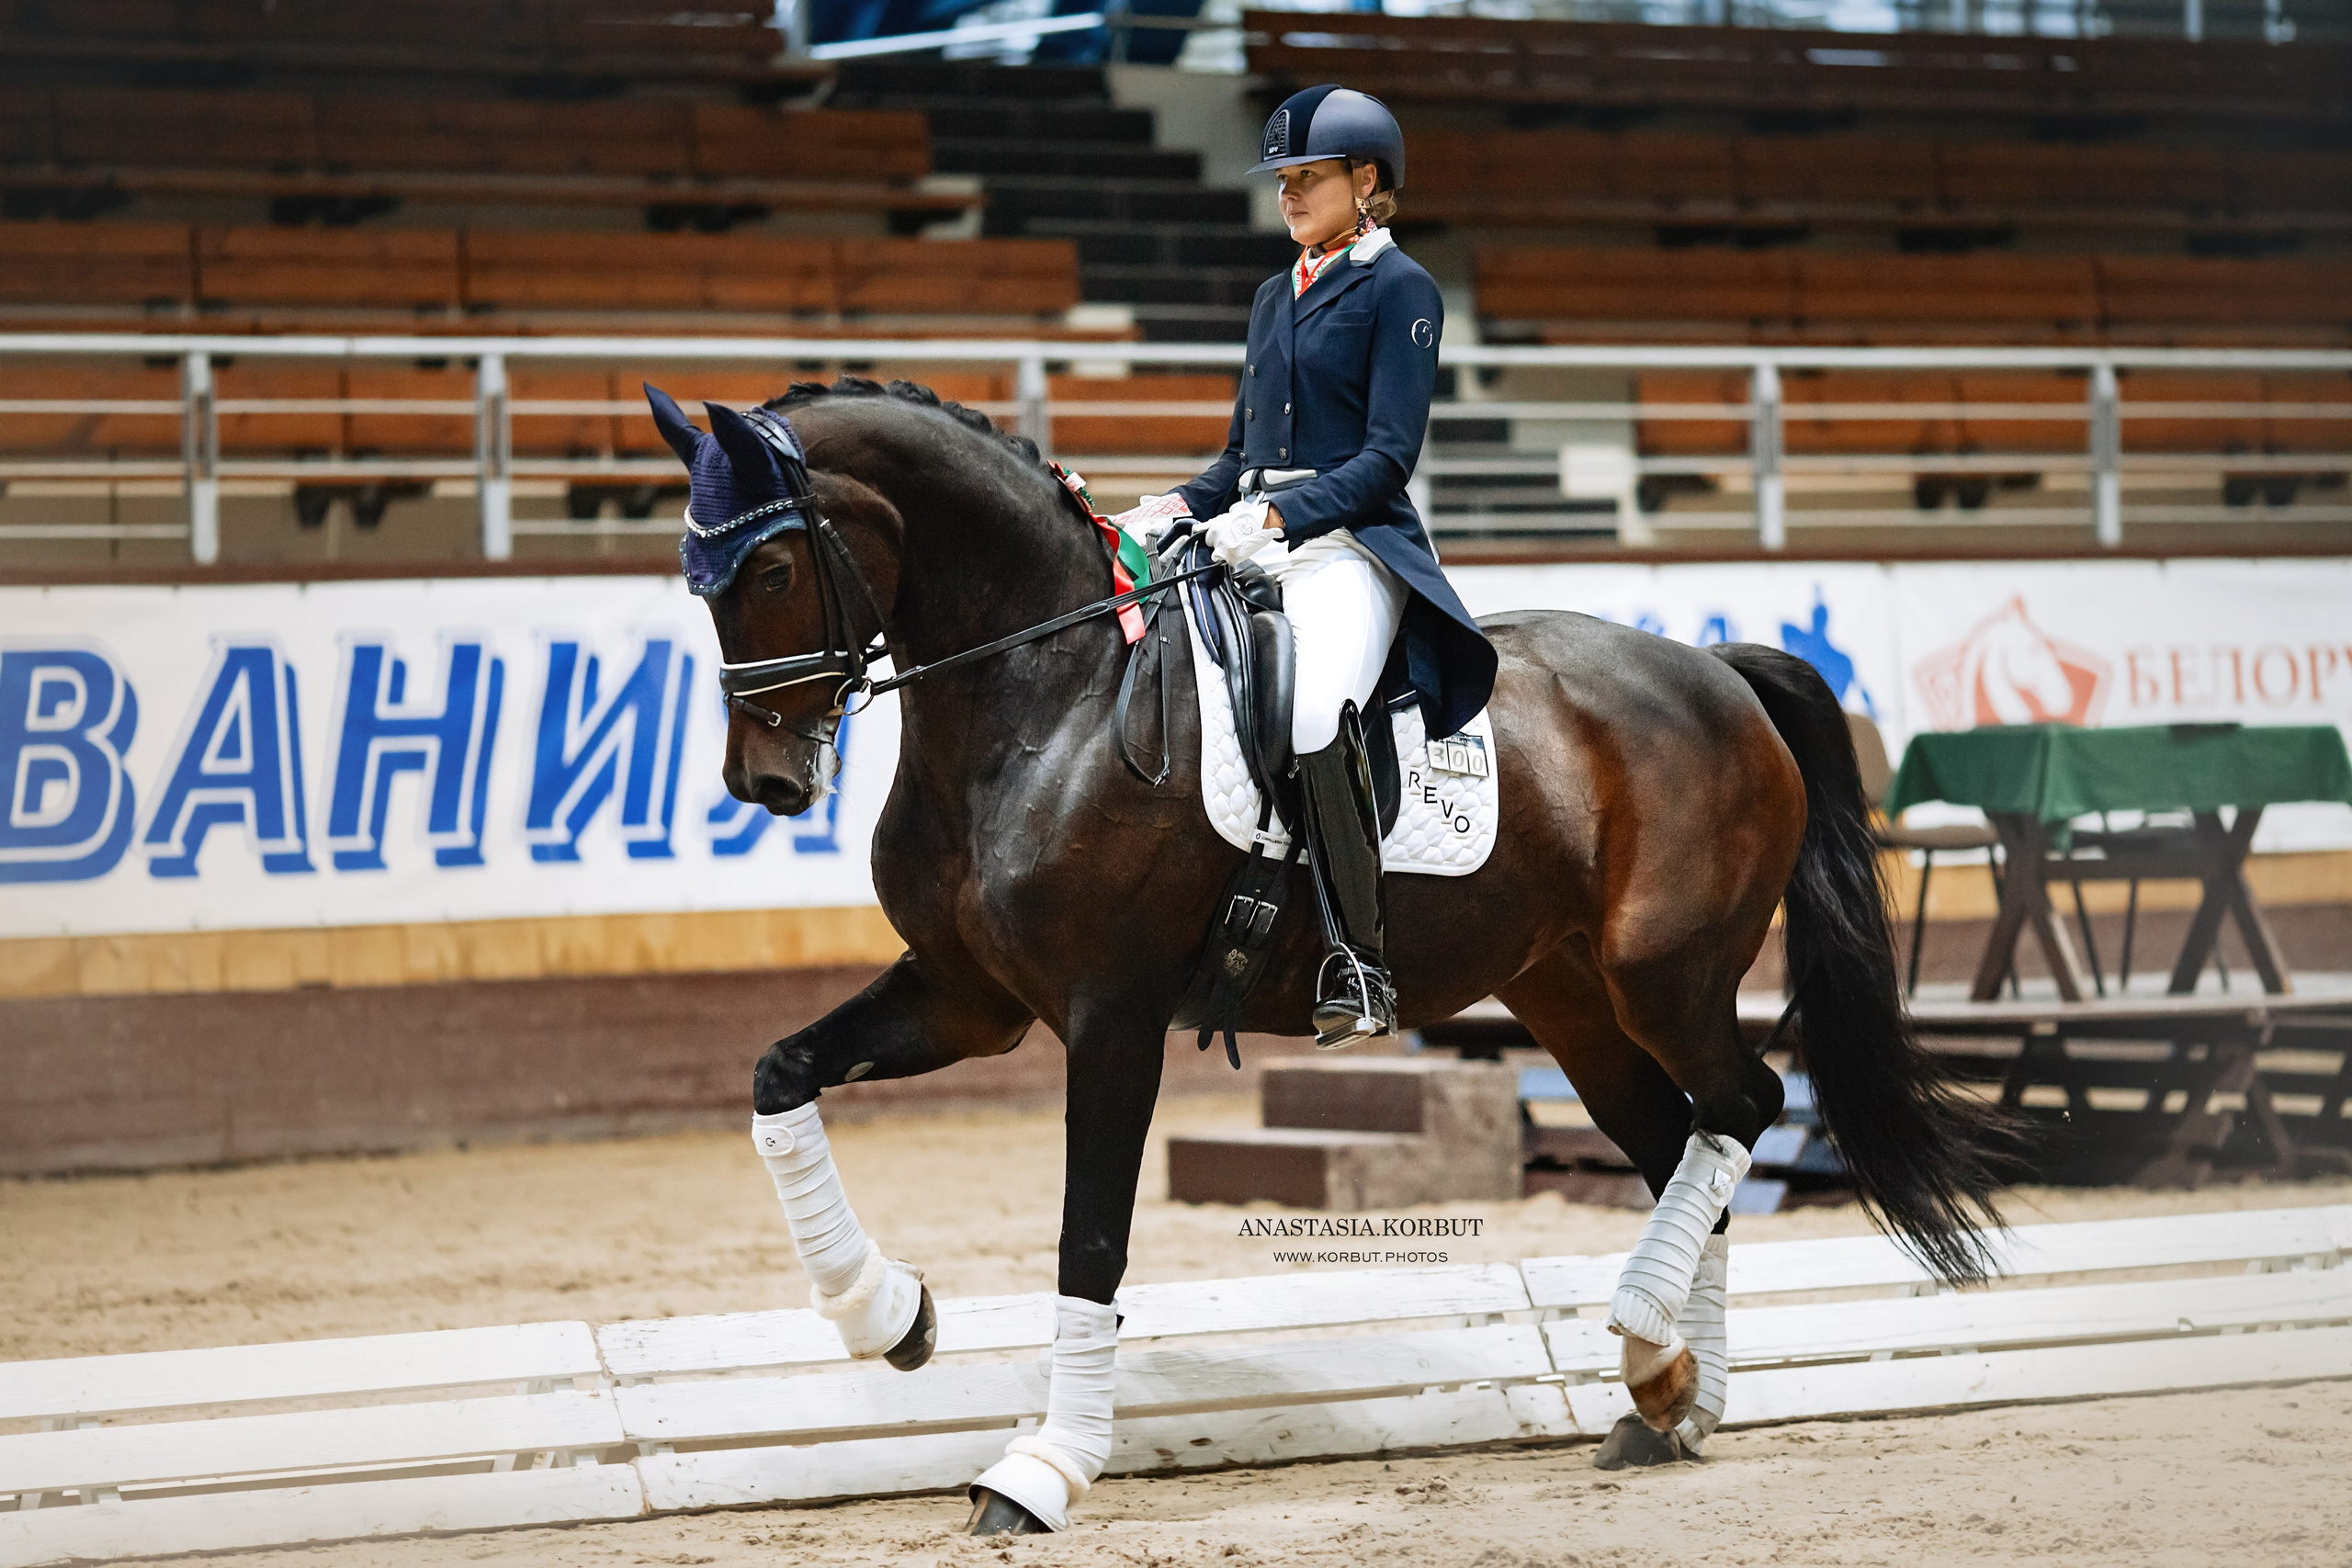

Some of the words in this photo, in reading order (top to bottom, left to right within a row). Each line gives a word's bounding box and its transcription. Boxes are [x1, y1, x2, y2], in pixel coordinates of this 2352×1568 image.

[2125, 645, 2352, 707] БЕЛОР
[1433, 748, 1483, 772] 300
[1408, 771, 1470, 833] REVO
